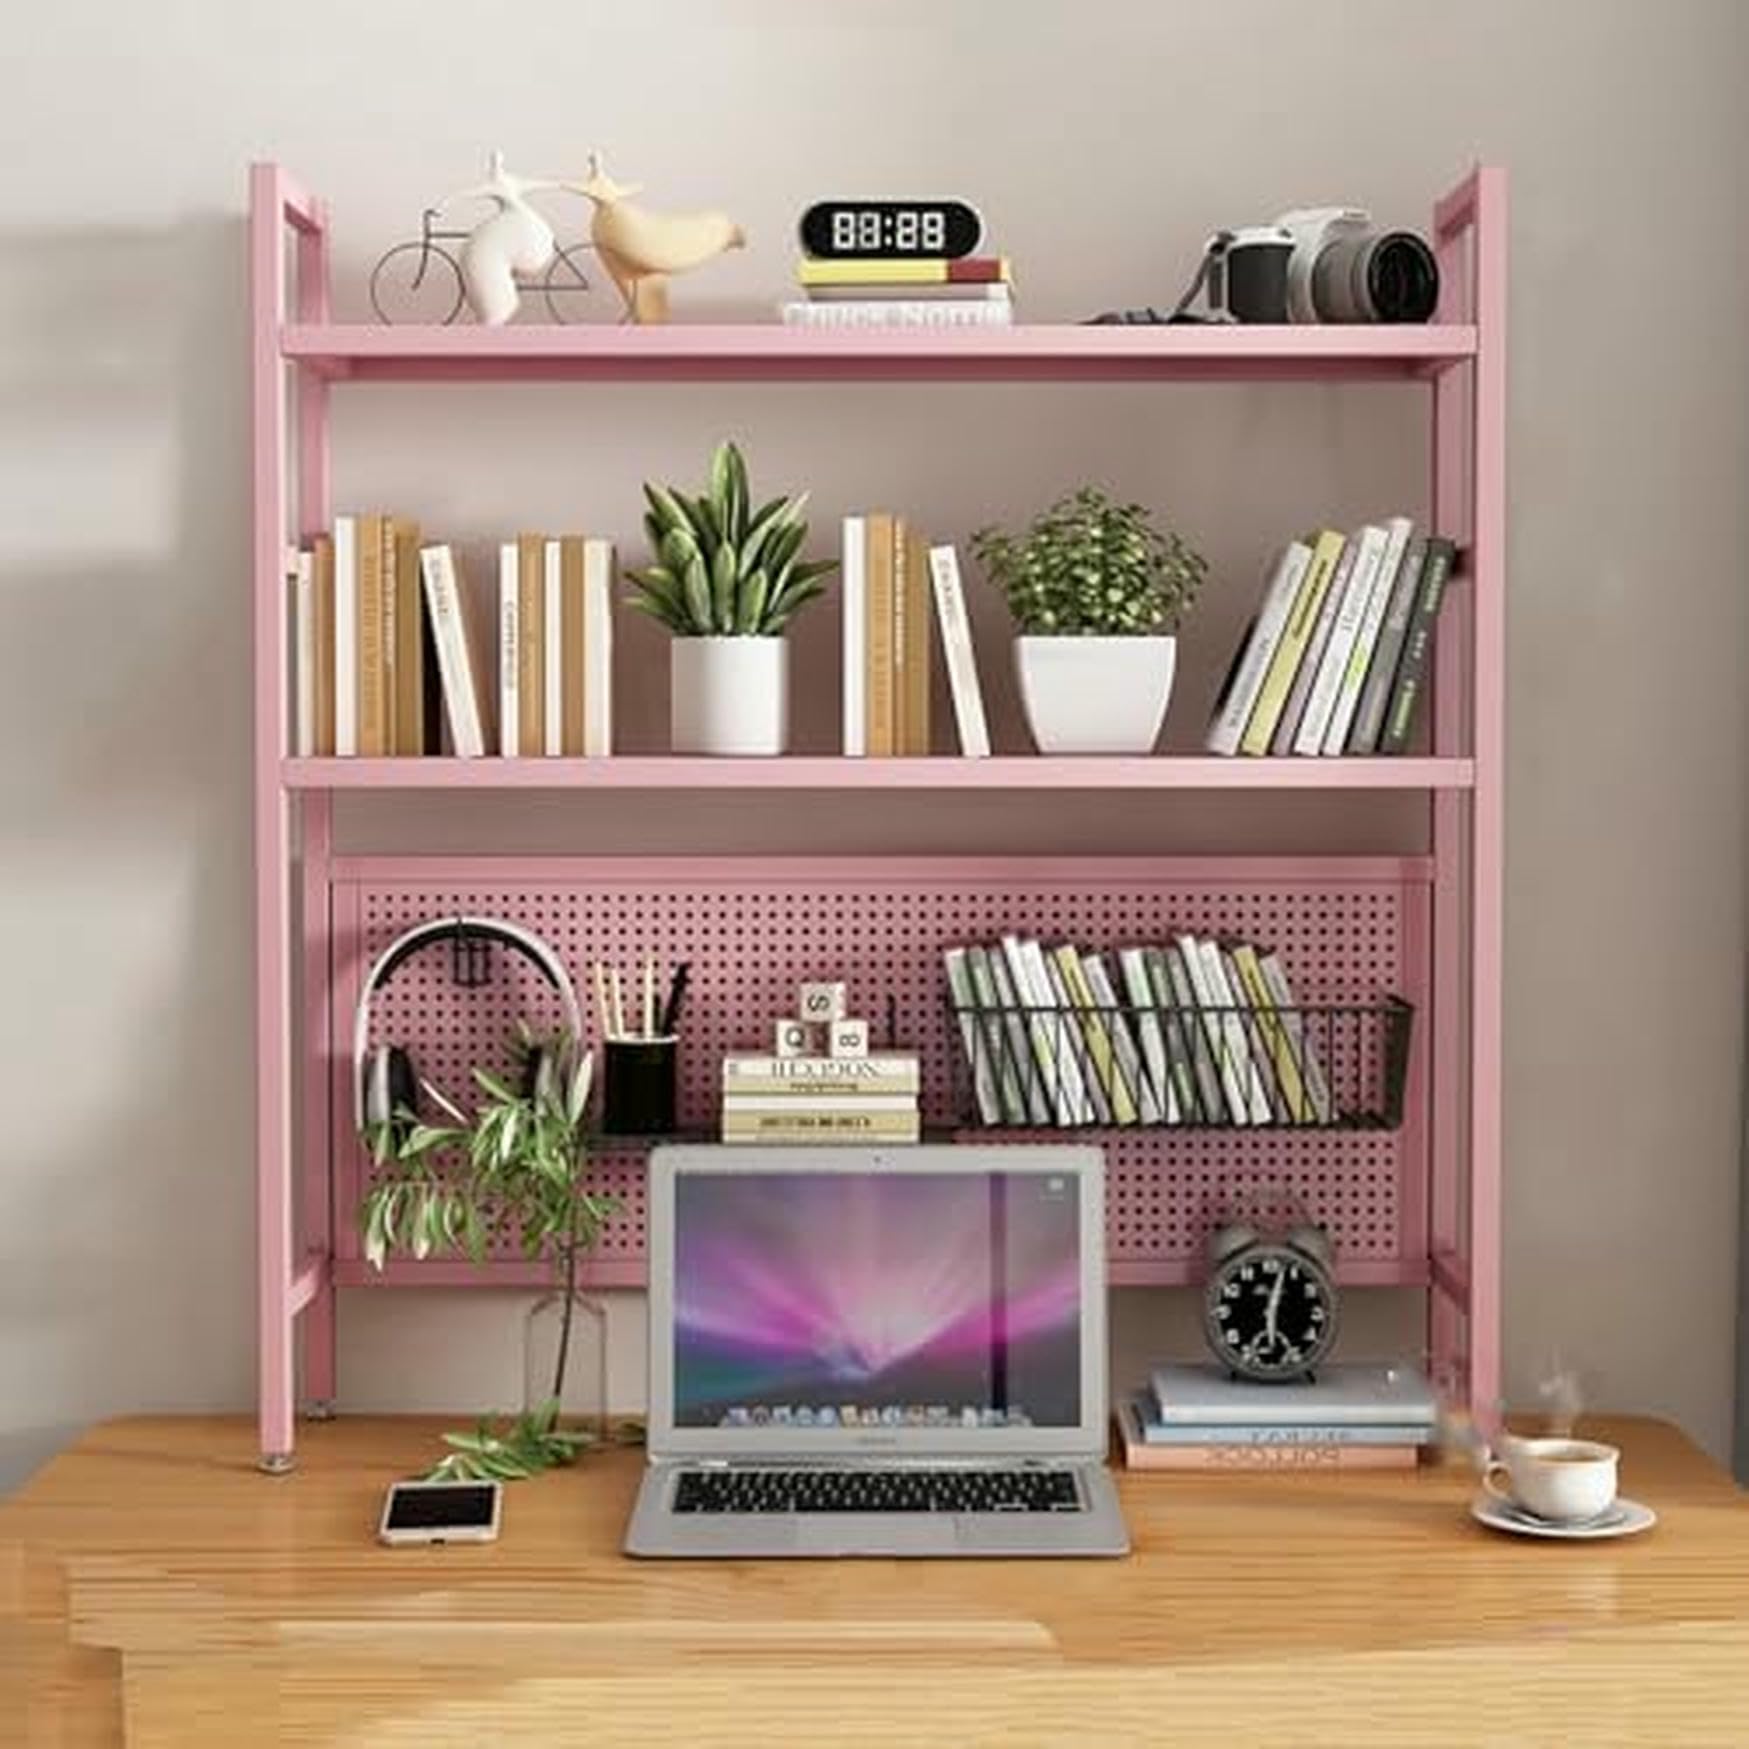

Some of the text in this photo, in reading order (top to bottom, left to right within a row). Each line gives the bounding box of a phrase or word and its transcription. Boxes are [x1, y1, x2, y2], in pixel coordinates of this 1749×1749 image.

[832, 212, 945, 250] 88:88
[807, 994, 830, 1011] S
[785, 1027, 806, 1048] Q
